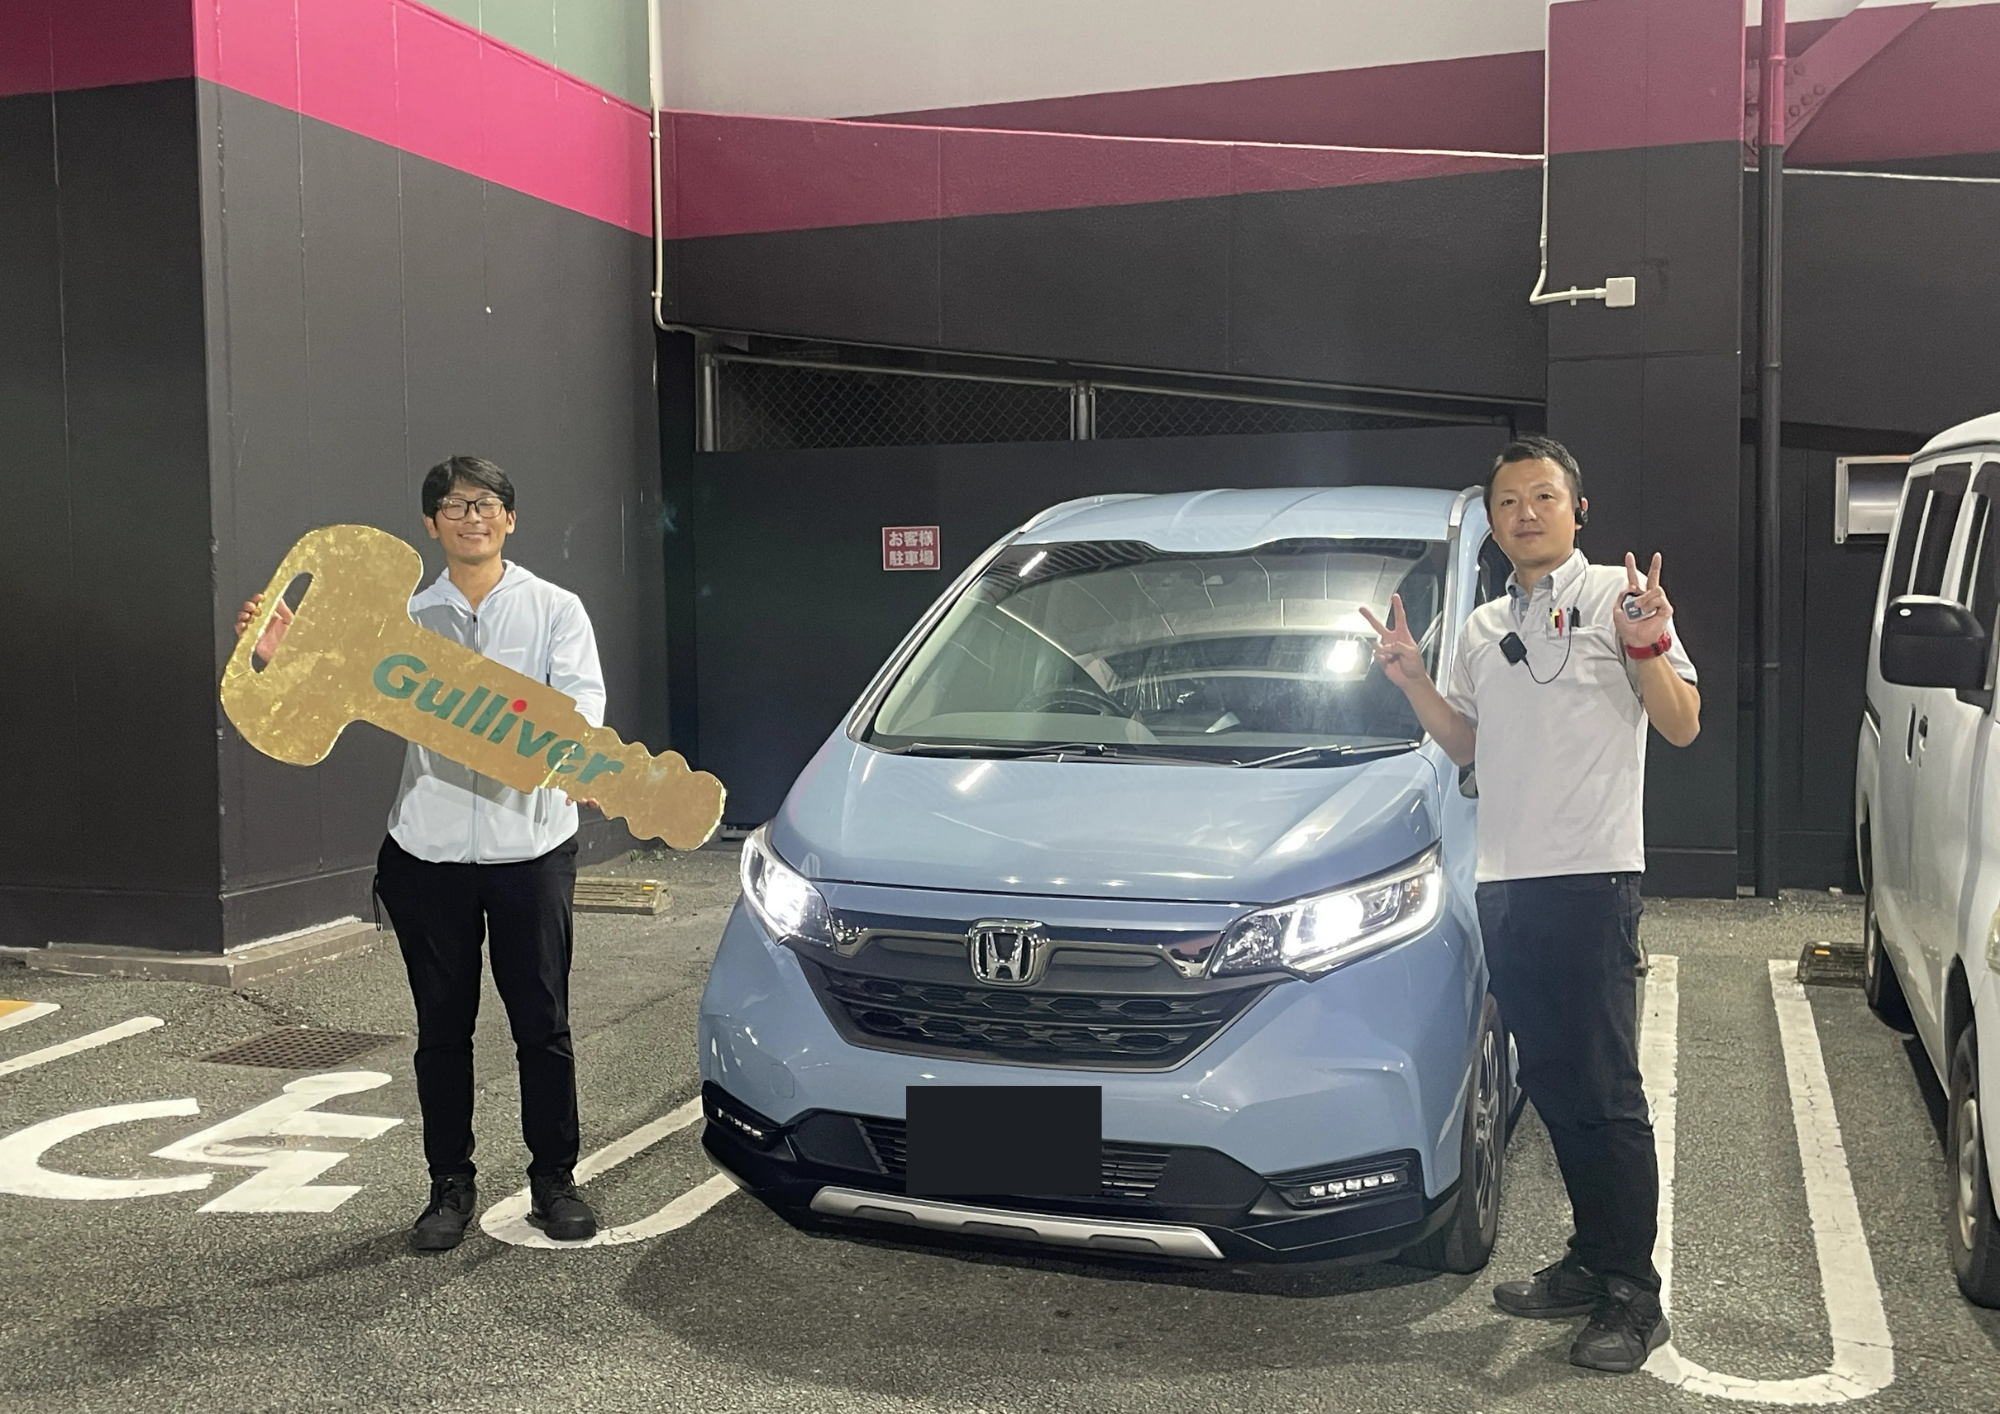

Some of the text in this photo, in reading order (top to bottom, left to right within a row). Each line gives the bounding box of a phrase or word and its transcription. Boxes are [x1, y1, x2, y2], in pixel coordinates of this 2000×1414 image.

[889, 530, 934, 547] お客様
[889, 549, 934, 567] 駐車場
[373, 654, 625, 784] Gulliver
